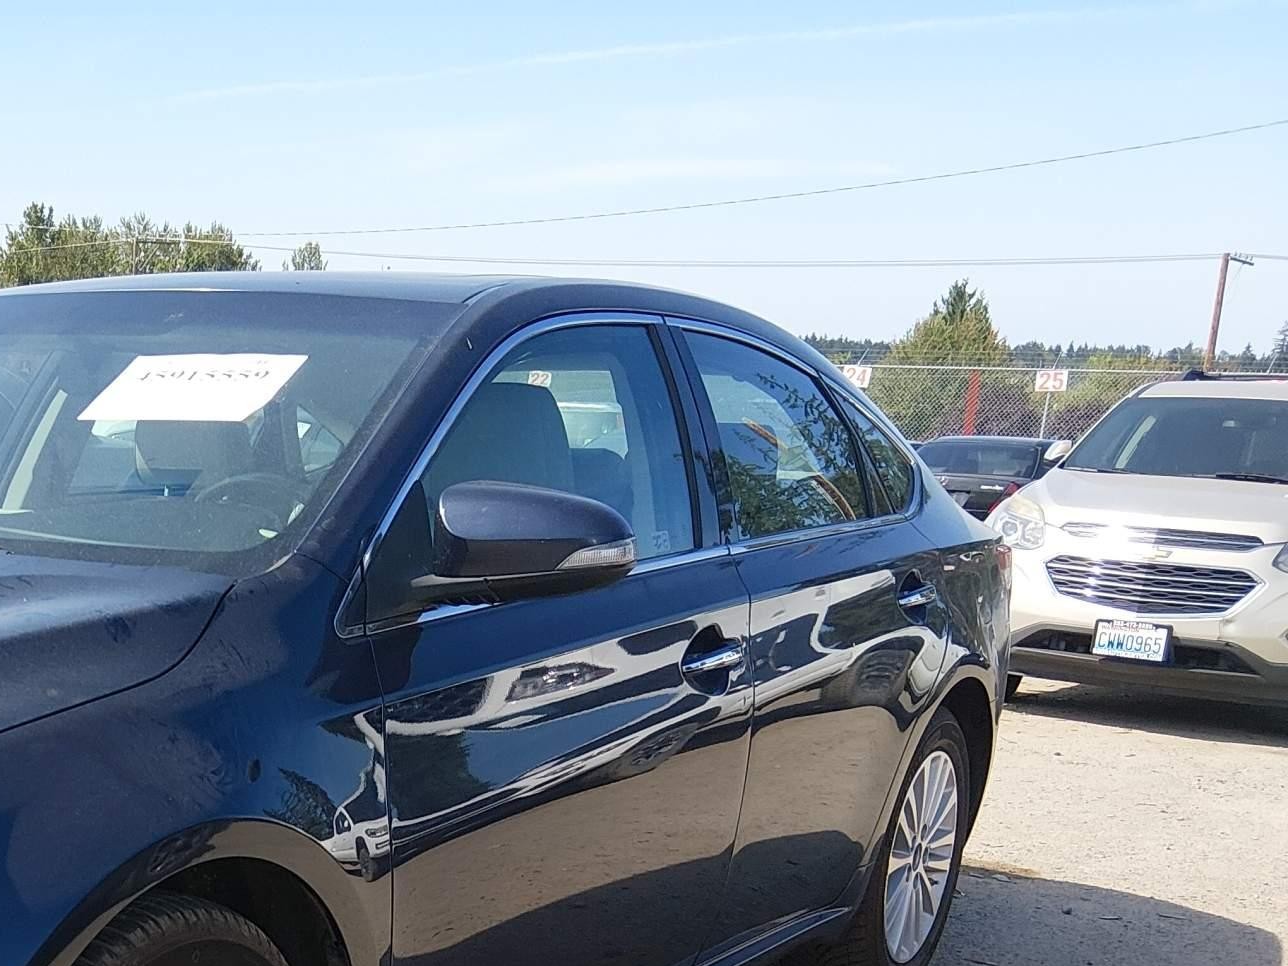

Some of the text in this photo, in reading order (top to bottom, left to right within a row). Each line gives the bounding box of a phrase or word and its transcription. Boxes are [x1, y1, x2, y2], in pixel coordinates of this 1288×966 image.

[530, 372, 550, 386] 22
[846, 367, 867, 386] 24
[1038, 371, 1065, 391] 25
[1097, 631, 1163, 654] CWW0965
